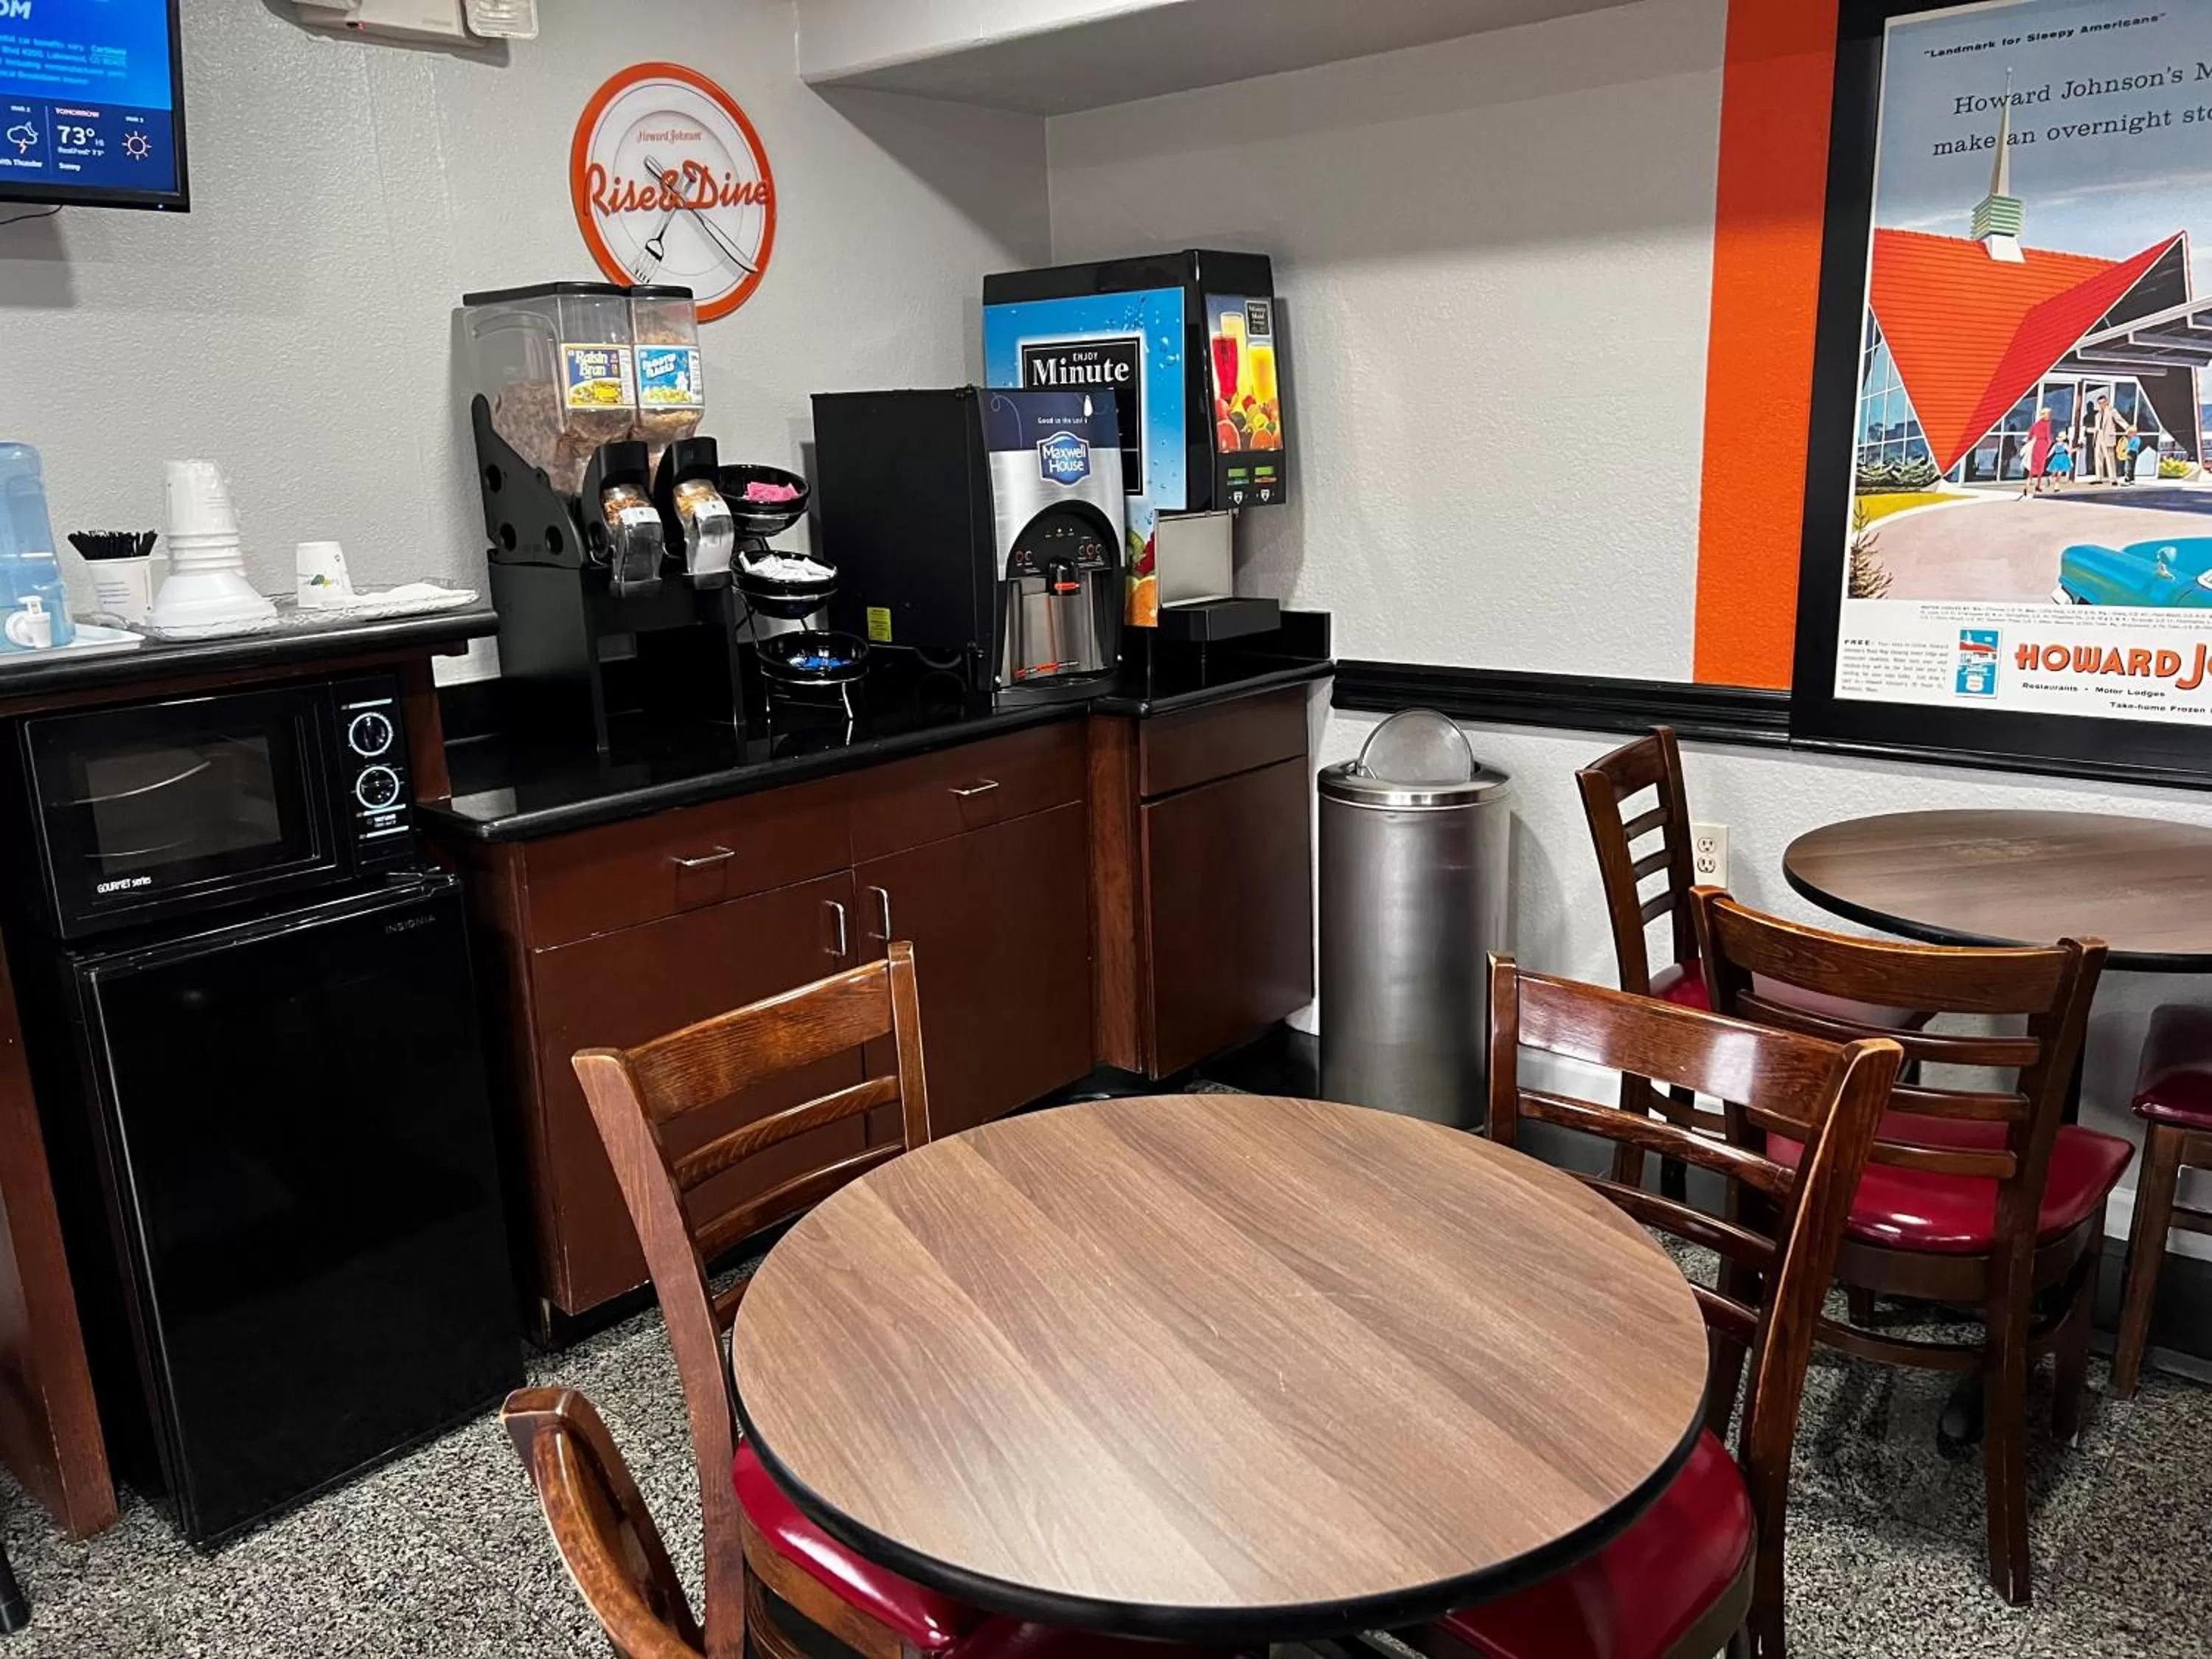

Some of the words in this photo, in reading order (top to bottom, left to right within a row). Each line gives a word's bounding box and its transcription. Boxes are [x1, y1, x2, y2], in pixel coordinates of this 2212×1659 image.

[2002, 37, 2022, 47] for
[2027, 27, 2075, 43] Sleepy
[1952, 85, 2051, 115] Howard
[2061, 66, 2184, 100] Johnson's
[1932, 134, 1997, 156] make
[2006, 130, 2036, 147] an
[2047, 108, 2172, 142] overnight
[1072, 351, 1099, 362] ENJOY
[1032, 357, 1130, 386] Minute
[1042, 444, 1086, 460] Maxwell
[1048, 458, 1085, 473] House
[2014, 642, 2182, 678] HOWARD
[2174, 642, 2212, 690] J
[2022, 682, 2079, 692] Restaurants
[2095, 686, 2123, 695] Motor
[2127, 689, 2166, 698] Lodges
